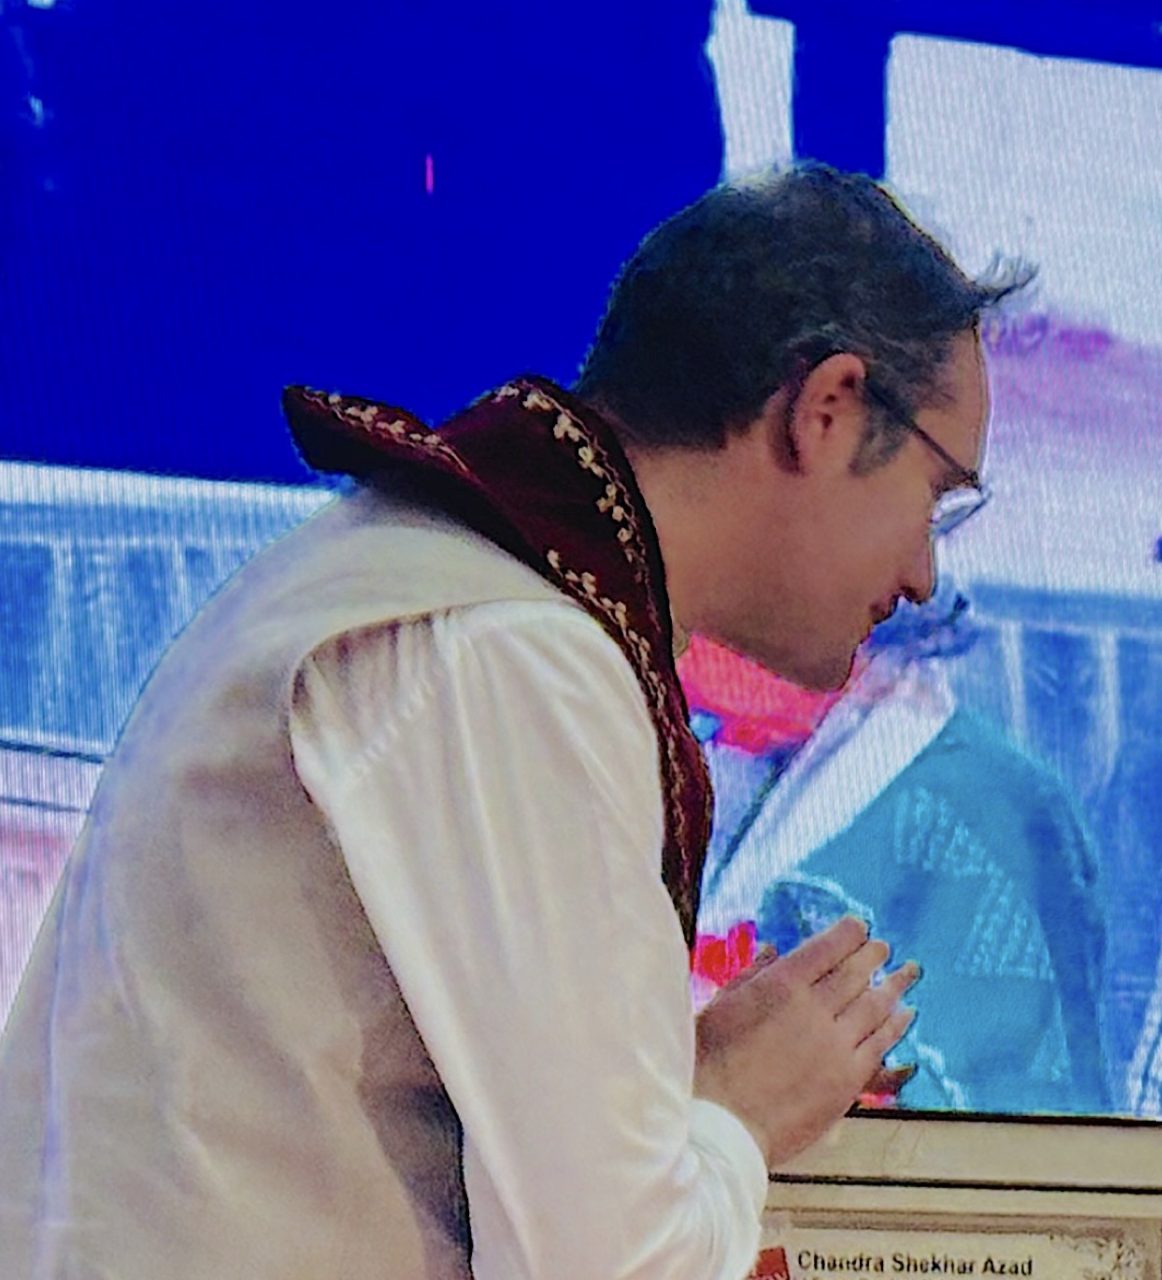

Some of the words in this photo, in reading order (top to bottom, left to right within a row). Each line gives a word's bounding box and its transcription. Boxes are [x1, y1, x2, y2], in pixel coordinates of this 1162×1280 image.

[798, 1250, 884, 1272] Chandra
[892, 1252, 975, 1274] Shekhar
[982, 1255, 1032, 1276] Azad
